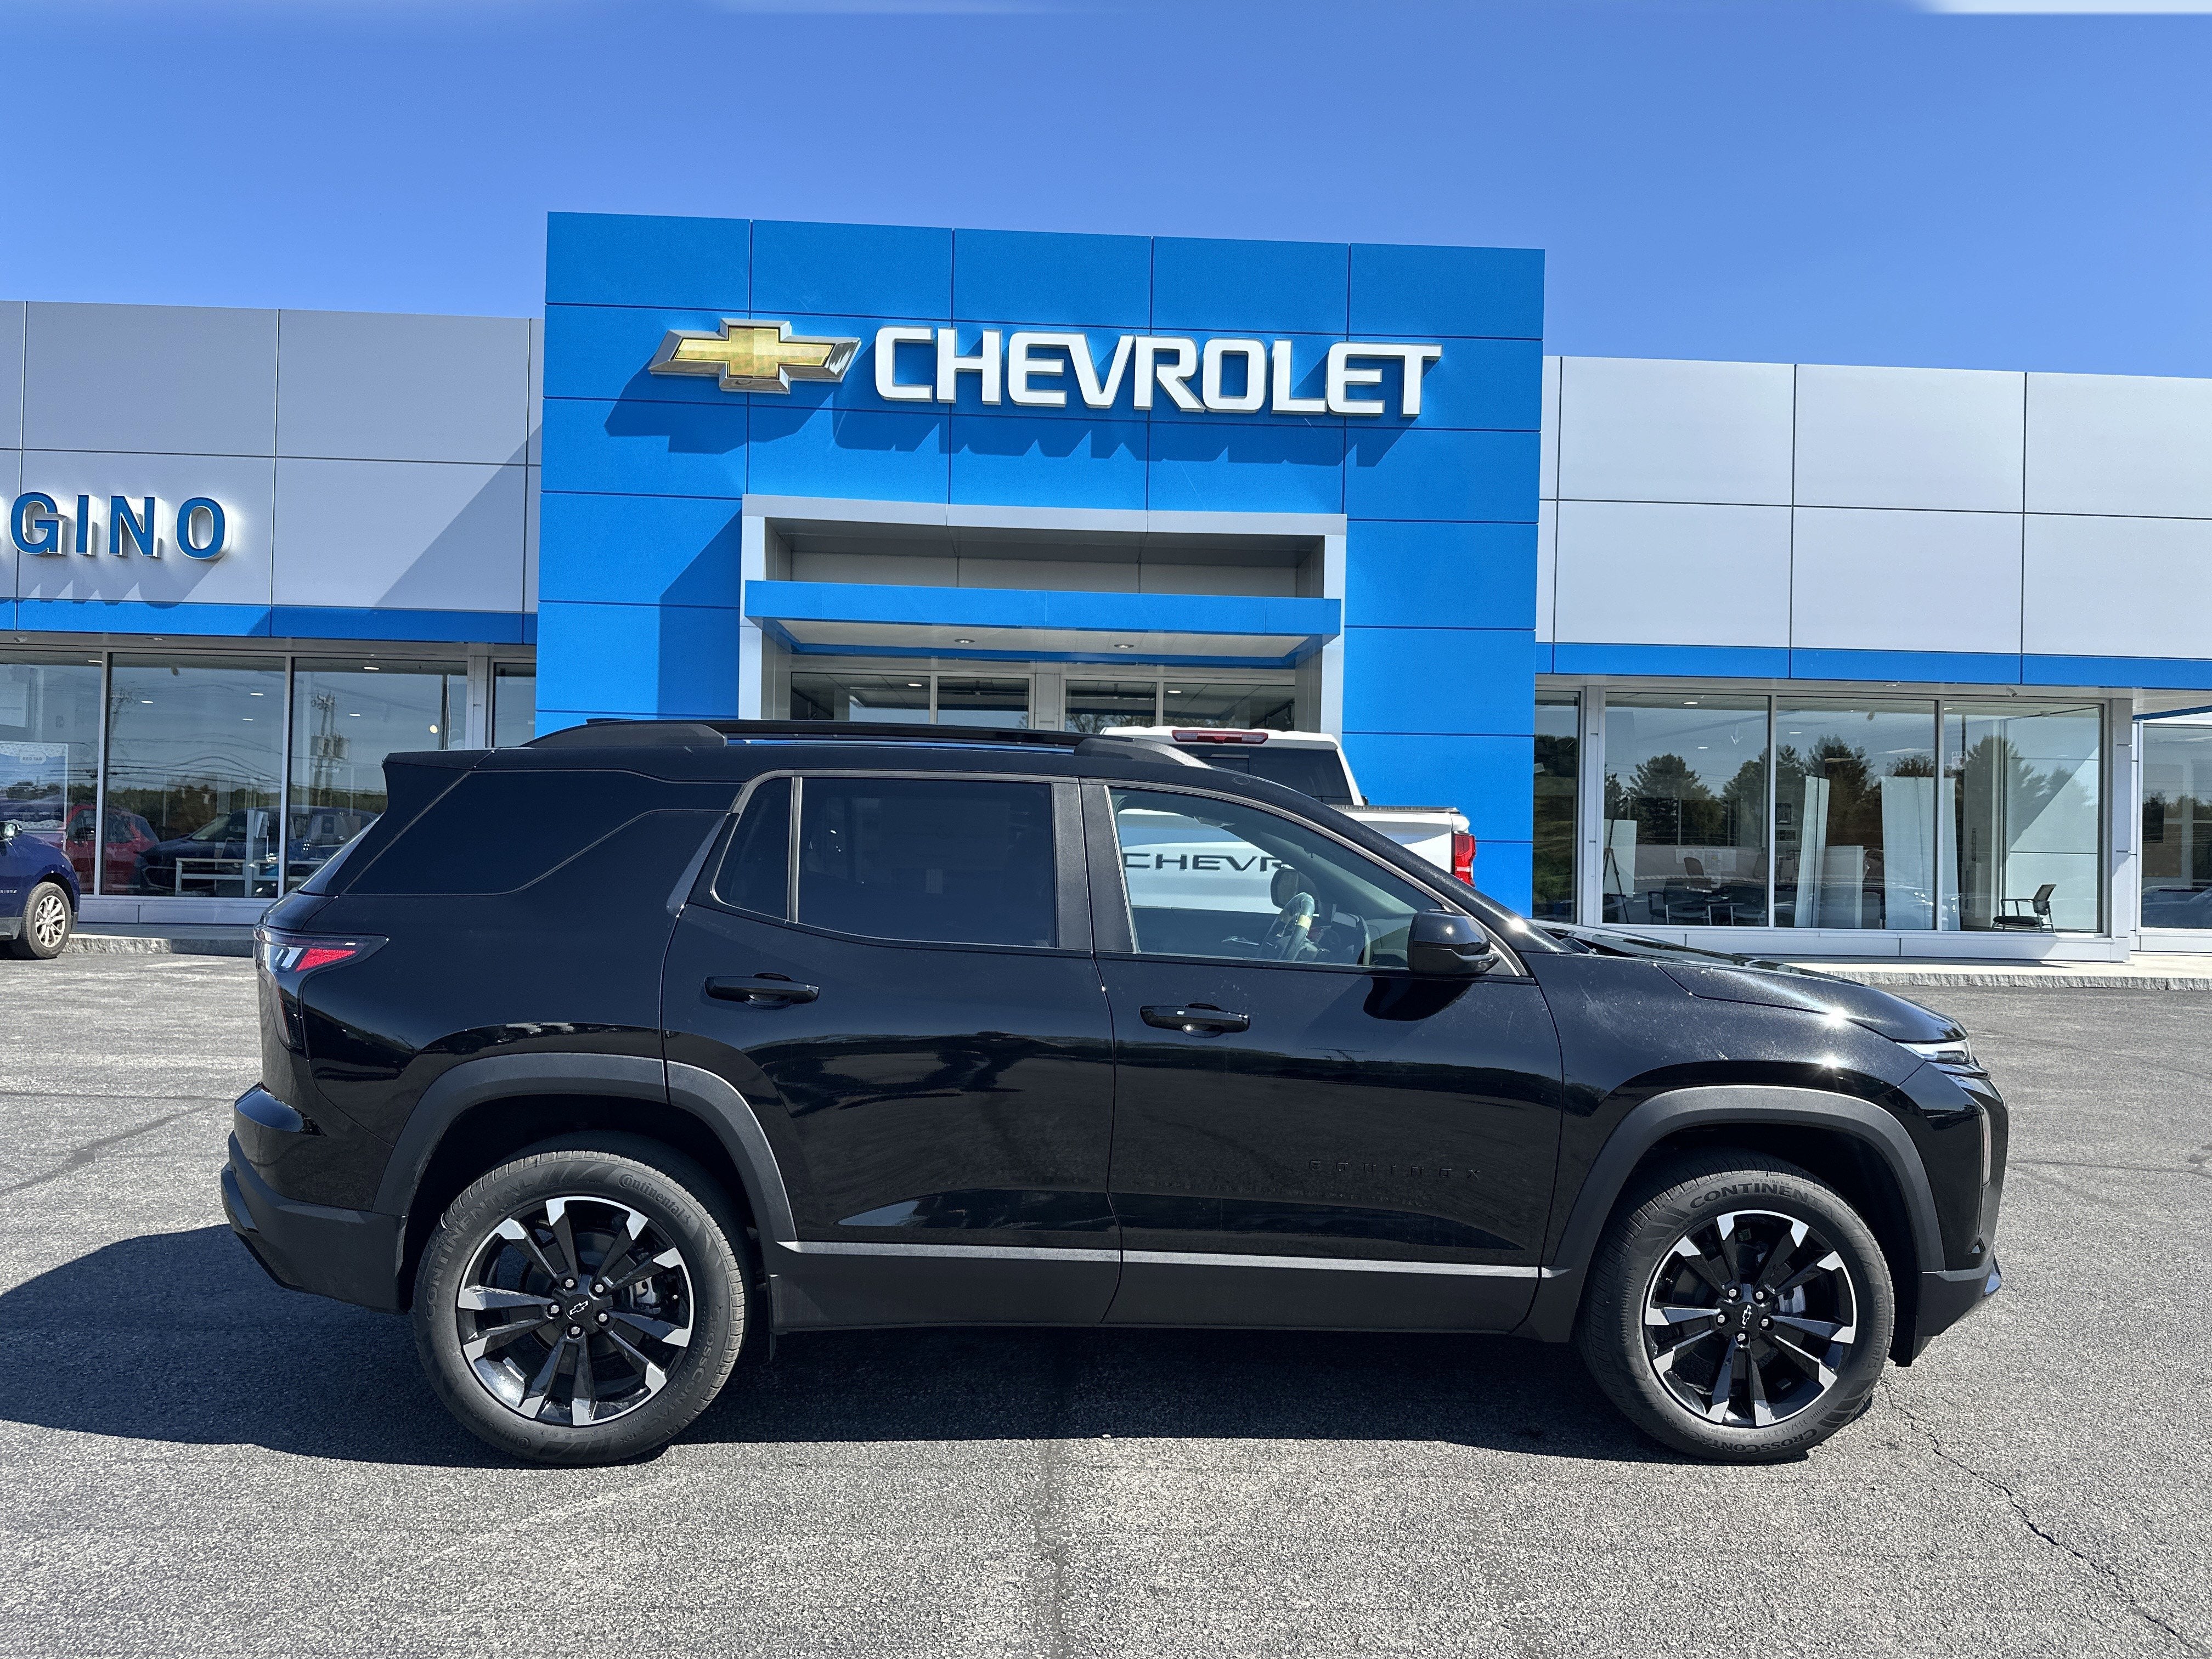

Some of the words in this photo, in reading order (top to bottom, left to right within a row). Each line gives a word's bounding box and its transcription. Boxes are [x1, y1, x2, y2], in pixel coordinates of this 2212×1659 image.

[874, 325, 1443, 417] CHEVROLET
[1309, 1160, 1480, 1180] EQUINOX
[618, 1173, 685, 1218] Continental
